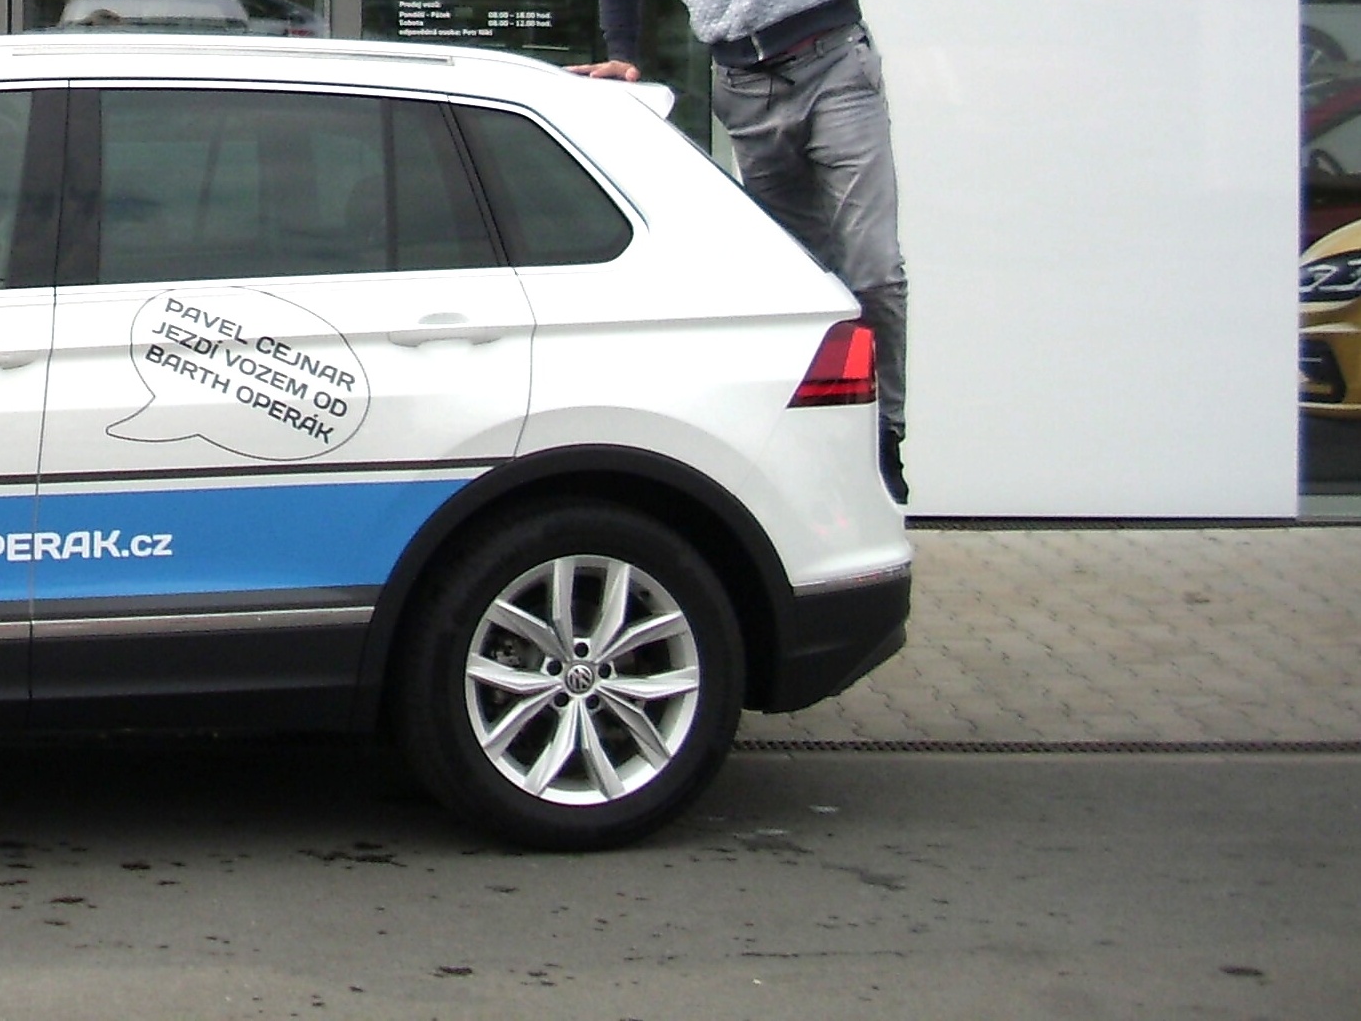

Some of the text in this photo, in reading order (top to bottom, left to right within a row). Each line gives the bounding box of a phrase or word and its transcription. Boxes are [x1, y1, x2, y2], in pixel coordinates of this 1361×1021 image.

[152, 321, 348, 417] JEZDÍ VOZEM OD
[165, 297, 356, 392] PAVEL CEJNAR
[145, 344, 335, 444] BARTH OPERÁK
